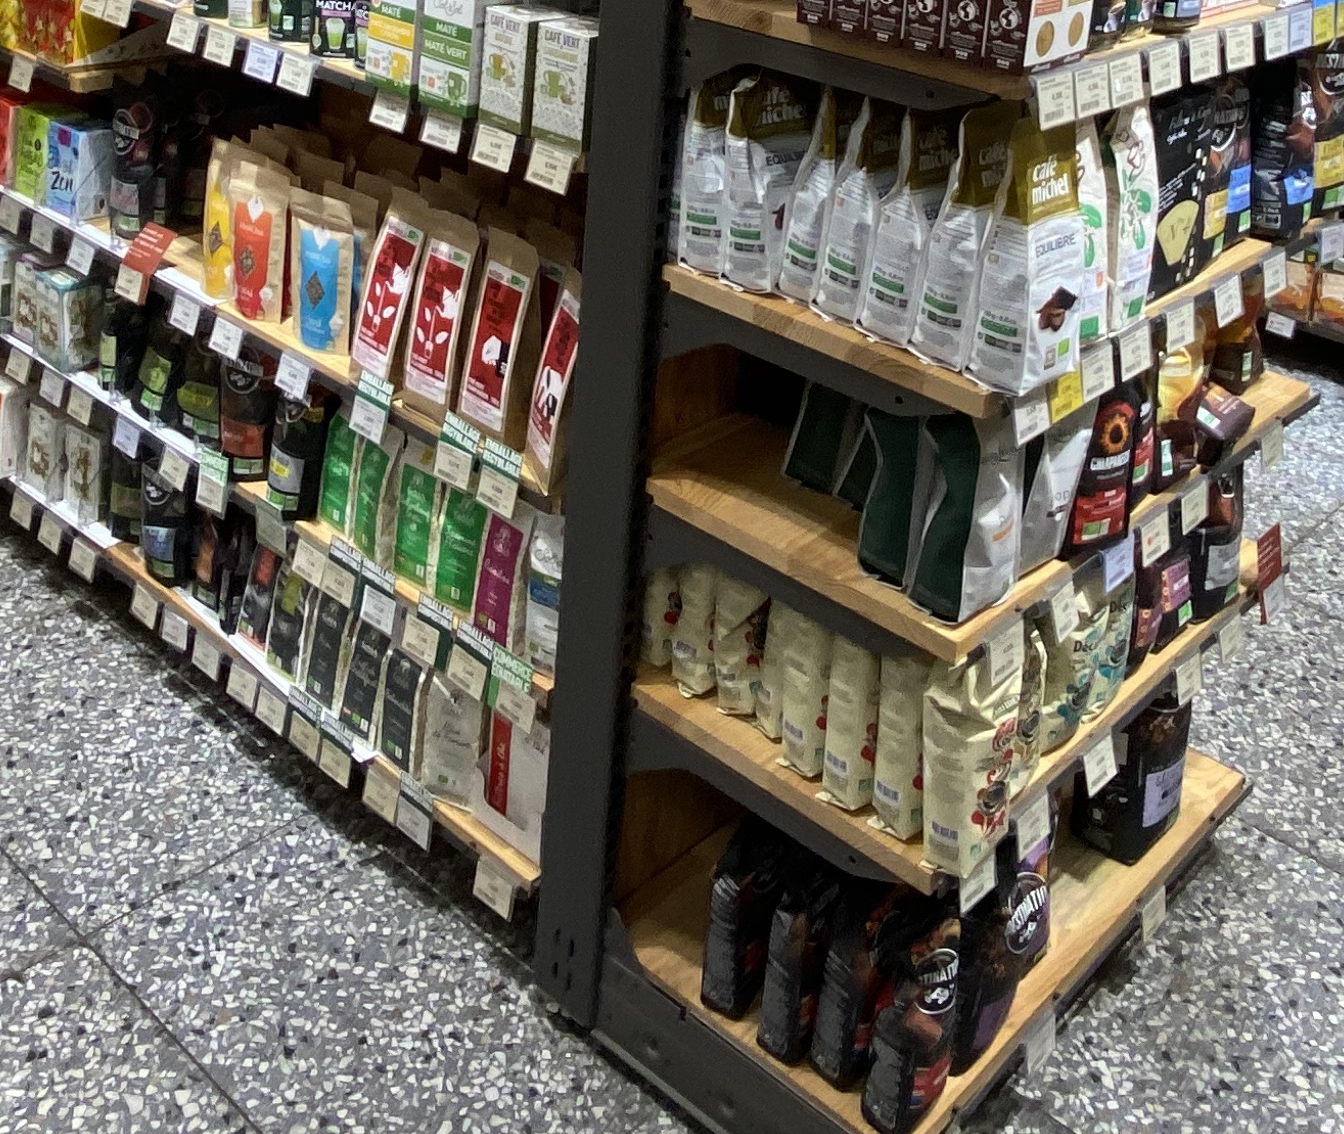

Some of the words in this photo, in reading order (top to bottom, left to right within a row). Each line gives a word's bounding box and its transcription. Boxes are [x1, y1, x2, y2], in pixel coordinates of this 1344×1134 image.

[380, 3, 401, 18] MATÉ
[435, 21, 457, 37] MATÉ
[424, 39, 446, 54] MATÉ
[446, 45, 468, 60] VERT
[544, 30, 562, 45] CAFÉ
[562, 35, 581, 49] VERT
[1032, 153, 1058, 183] café
[1031, 172, 1069, 205] michel
